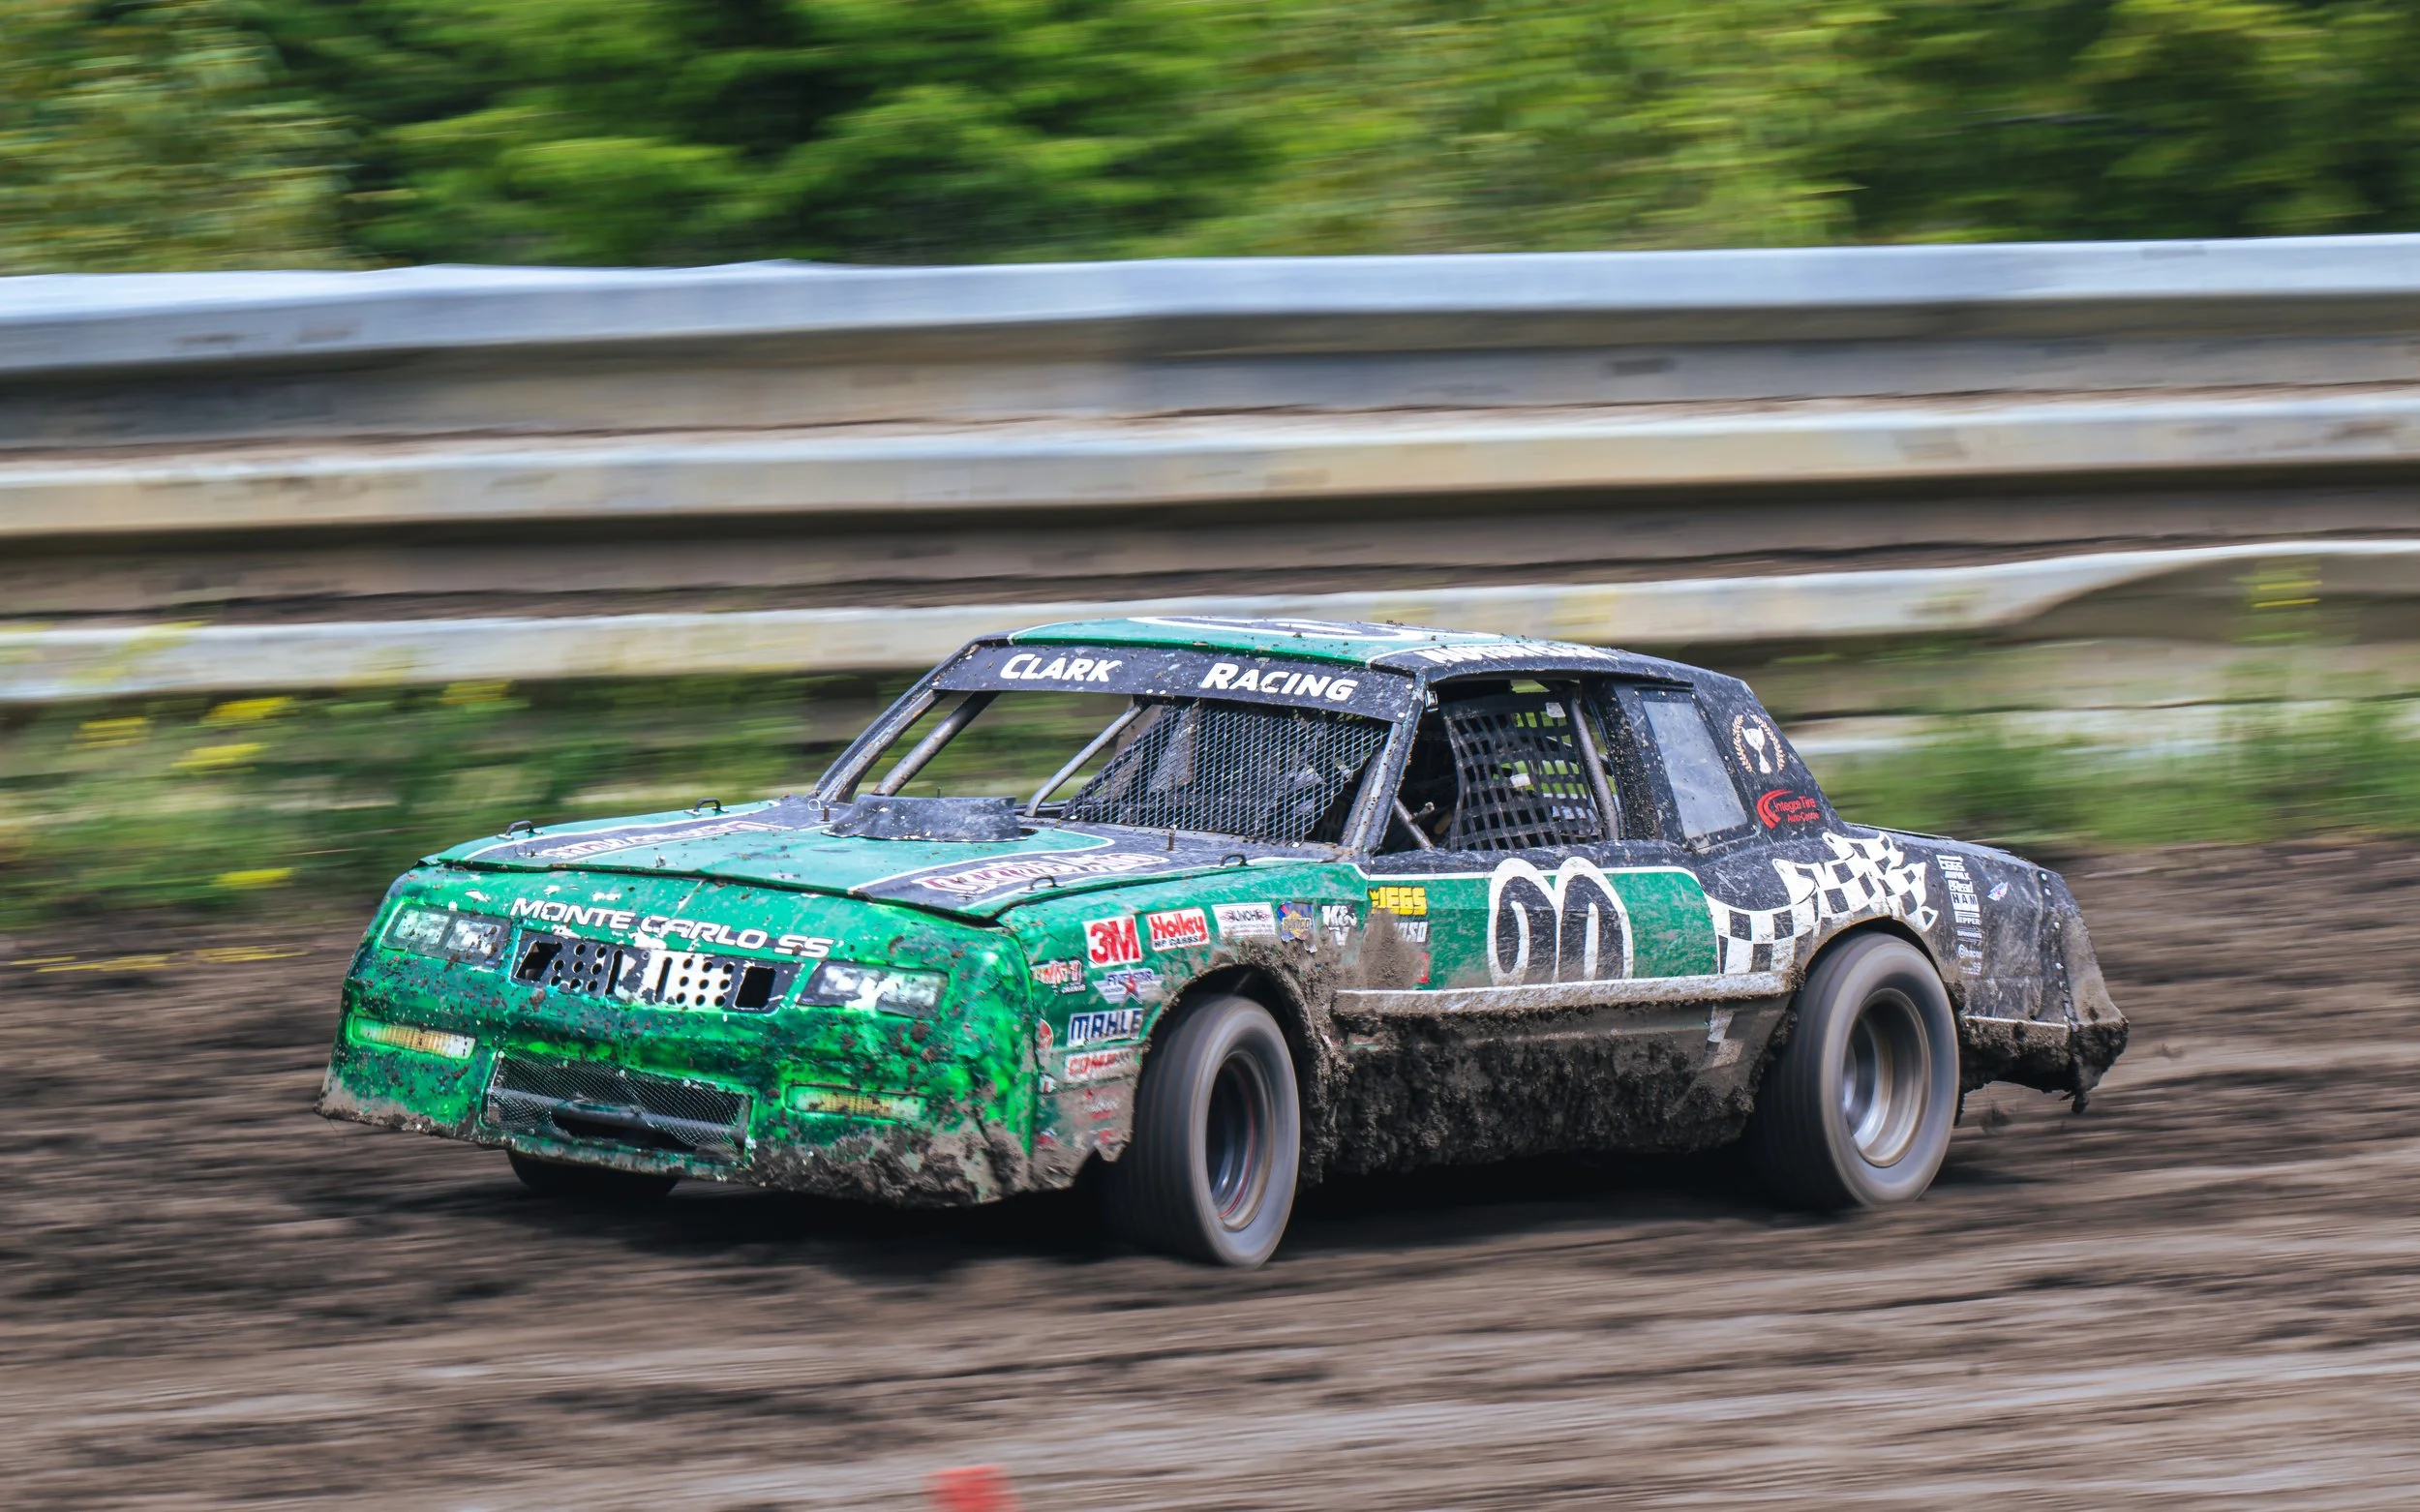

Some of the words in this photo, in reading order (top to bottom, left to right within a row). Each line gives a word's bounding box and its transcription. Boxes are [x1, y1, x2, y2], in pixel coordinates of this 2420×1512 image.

[1000, 653, 1121, 681] CLARK
[1201, 663, 1357, 701] RACING
[1372, 887, 1427, 915] JEGS
[509, 898, 636, 929] MONTE
[641, 916, 768, 949] CARLO
[774, 935, 834, 957] SS
[1090, 920, 1140, 964] 3M
[1151, 913, 1207, 941] Holley
[1071, 1010, 1142, 1041] MAHLE
